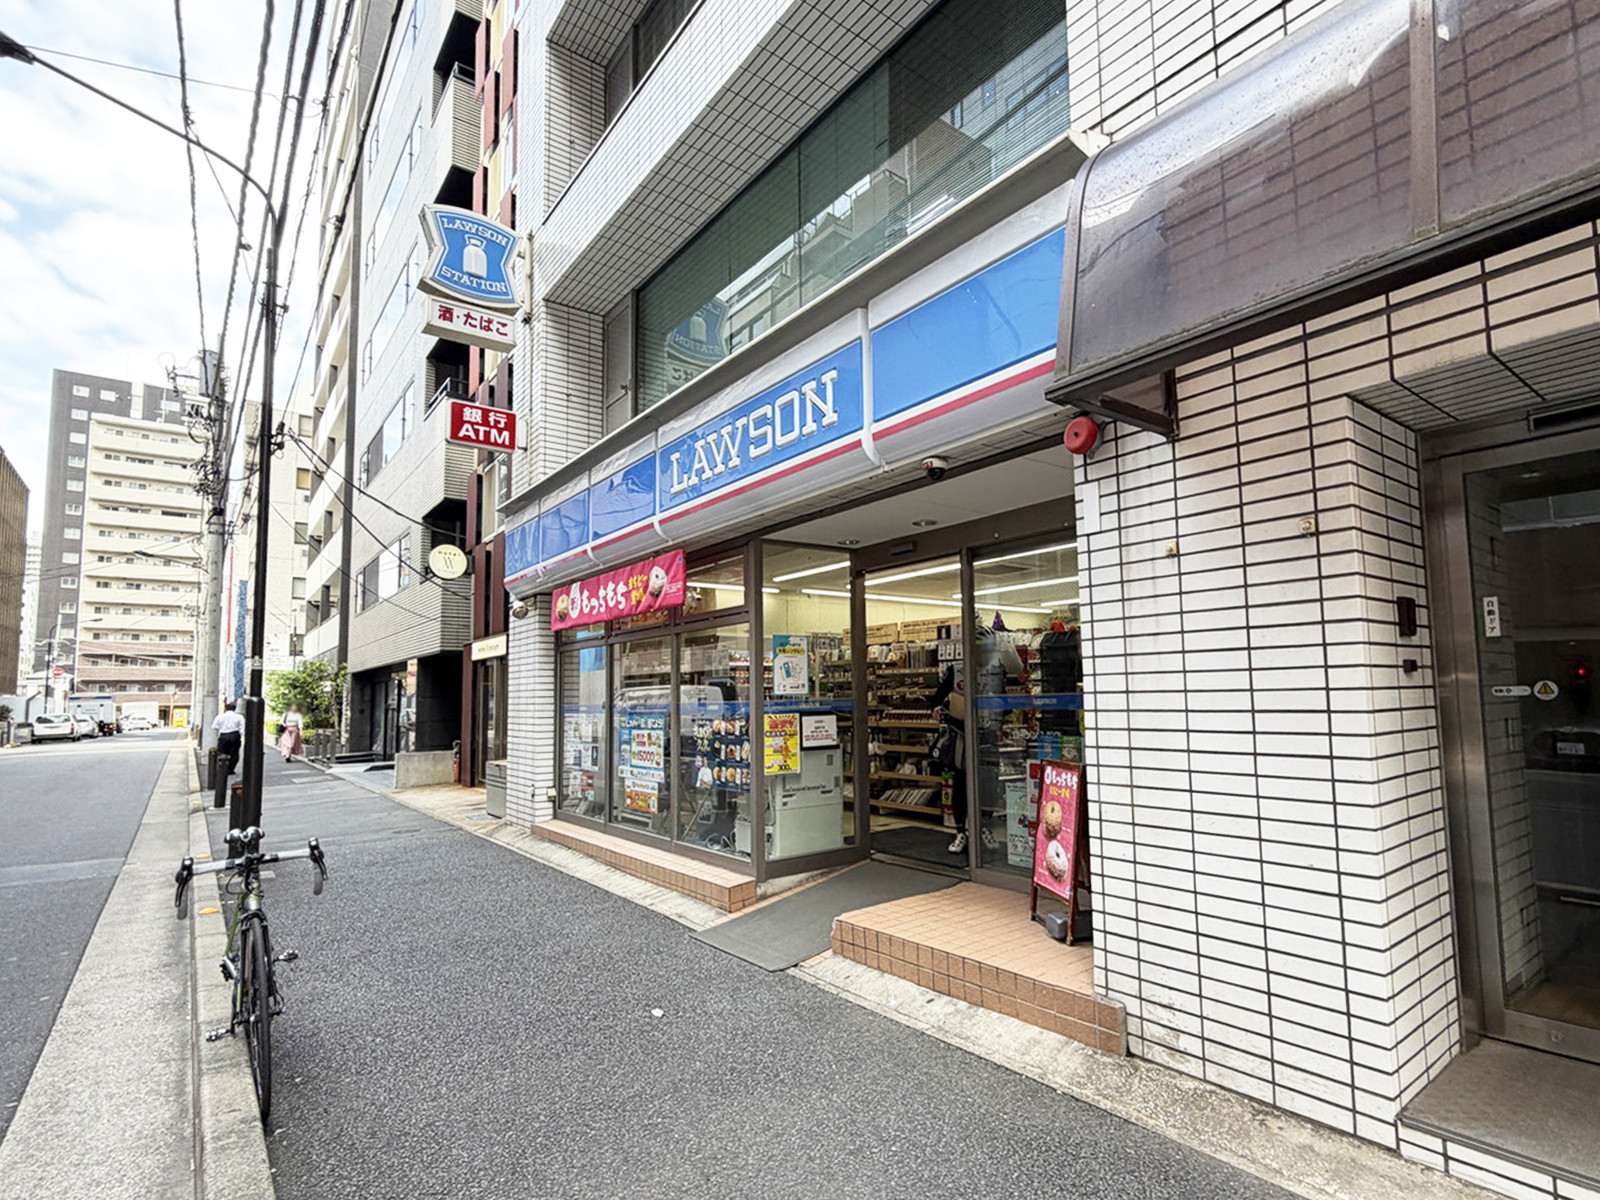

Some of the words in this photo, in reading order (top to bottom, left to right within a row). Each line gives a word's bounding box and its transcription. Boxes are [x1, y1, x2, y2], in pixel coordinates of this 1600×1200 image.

[441, 218, 508, 247] LAWSON
[440, 266, 507, 294] STATION
[437, 305, 509, 337] 酒・たばこ
[462, 406, 508, 428] 銀行
[458, 422, 510, 446] ATM
[669, 368, 839, 496] LAWSON
[581, 580, 628, 615] もっちもち
